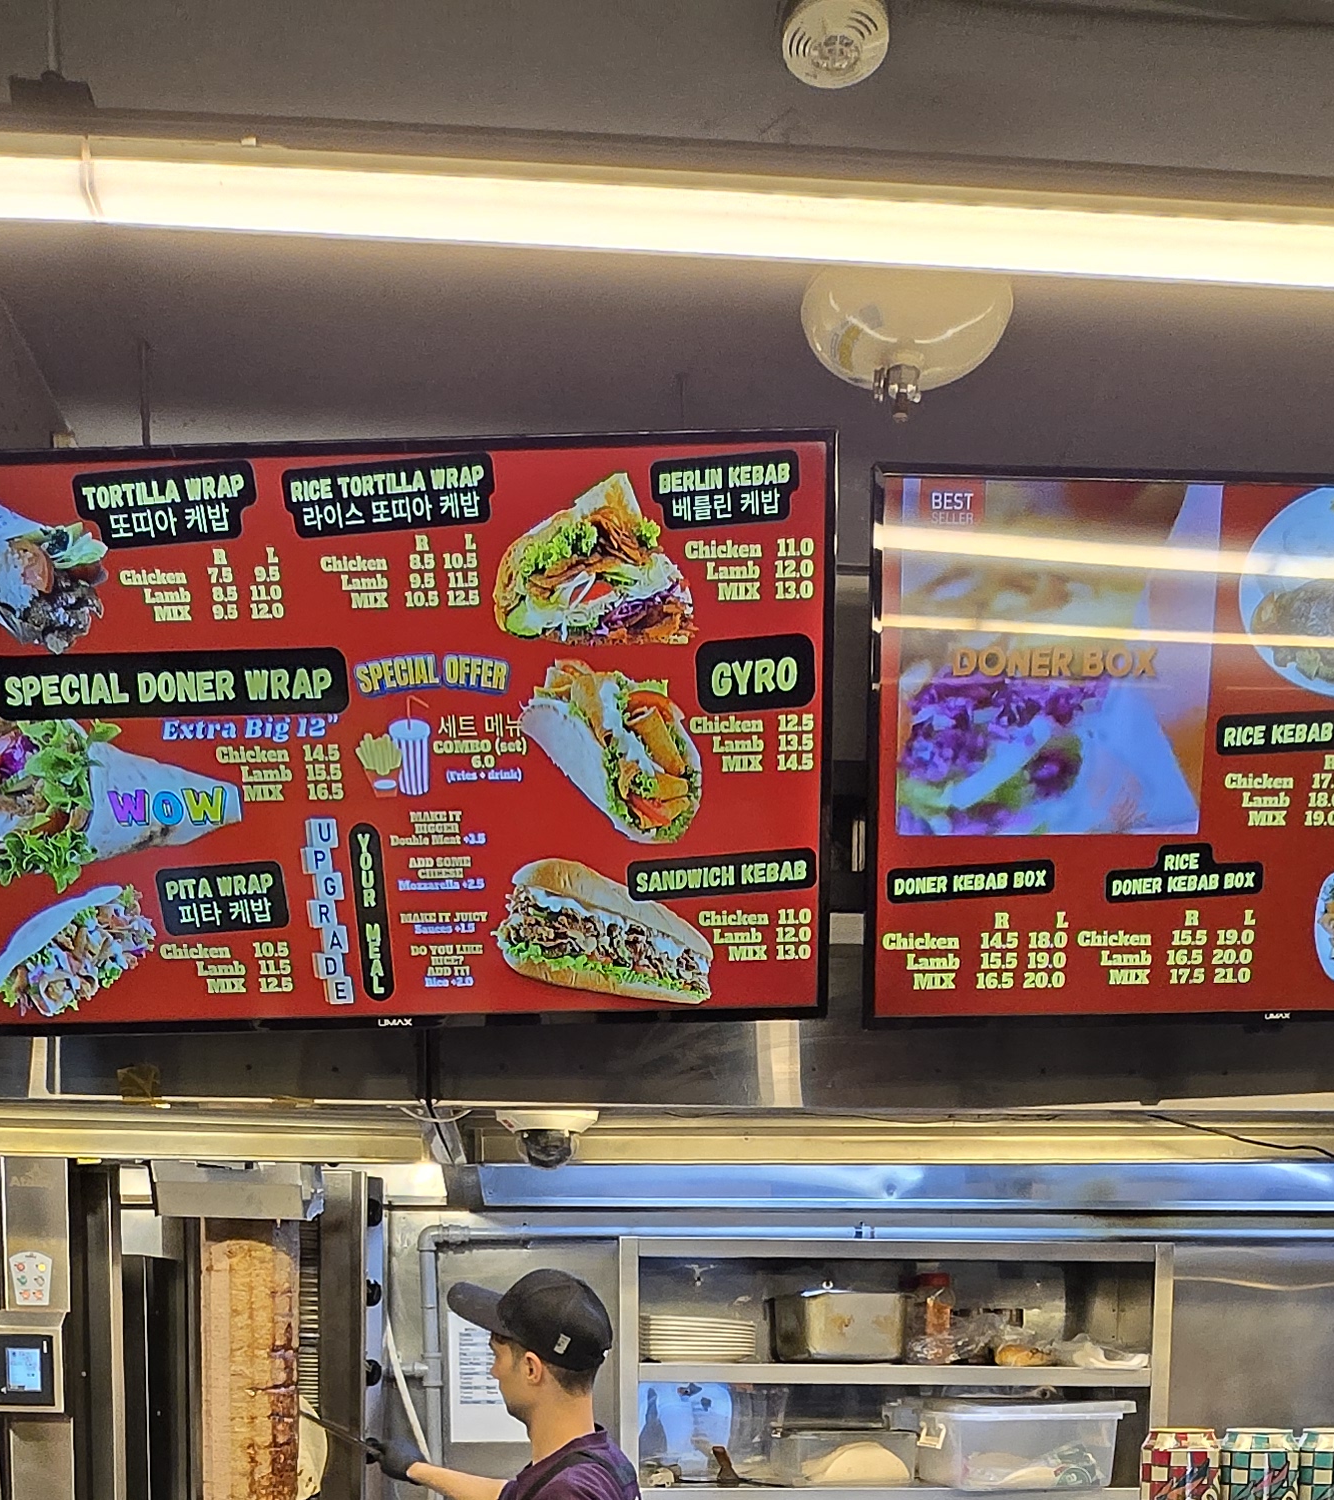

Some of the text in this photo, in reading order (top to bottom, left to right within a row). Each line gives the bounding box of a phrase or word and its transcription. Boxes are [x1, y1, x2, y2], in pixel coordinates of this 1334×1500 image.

[83, 474, 245, 510] TORTILLA WRAP
[291, 466, 484, 502] RICE TORTILLA WRAP
[658, 462, 790, 494] BERLIN KEBAB
[302, 492, 480, 532] 라이스 또띠아 케밥
[672, 490, 780, 521] 베를린 케밥
[931, 493, 974, 509] BEST
[109, 503, 230, 539] 또띠아 케밥
[931, 512, 974, 525] SELLER
[685, 539, 814, 559] Chicken 11.0
[120, 566, 280, 586] Chicken 7.5 9.5
[707, 560, 814, 580] Lamb 12.0
[355, 658, 509, 692] SPECIAL OFFER
[711, 658, 797, 695] GYRO
[953, 647, 1158, 677] DONER BOX
[6, 668, 332, 706] SPECIAL DONER WRAP
[162, 719, 237, 740] Extra
[244, 717, 289, 741] Big
[438, 713, 521, 737] 세트 메뉴
[1224, 723, 1265, 747] RICE
[1271, 721, 1333, 744] KEBAB
[1224, 773, 1293, 790] Chicken
[109, 787, 226, 826] WOW
[356, 834, 376, 907] YOUR
[636, 859, 807, 893] SANDWICH KEBAB
[1164, 854, 1198, 871] RICE
[166, 874, 273, 901] PITA WRAP
[895, 870, 1046, 895] DONER KEBAB BOX
[179, 898, 272, 928] 피타 케밥
[365, 924, 384, 994] MEAL
[913, 972, 1065, 989] MIX 16.5 20.0
